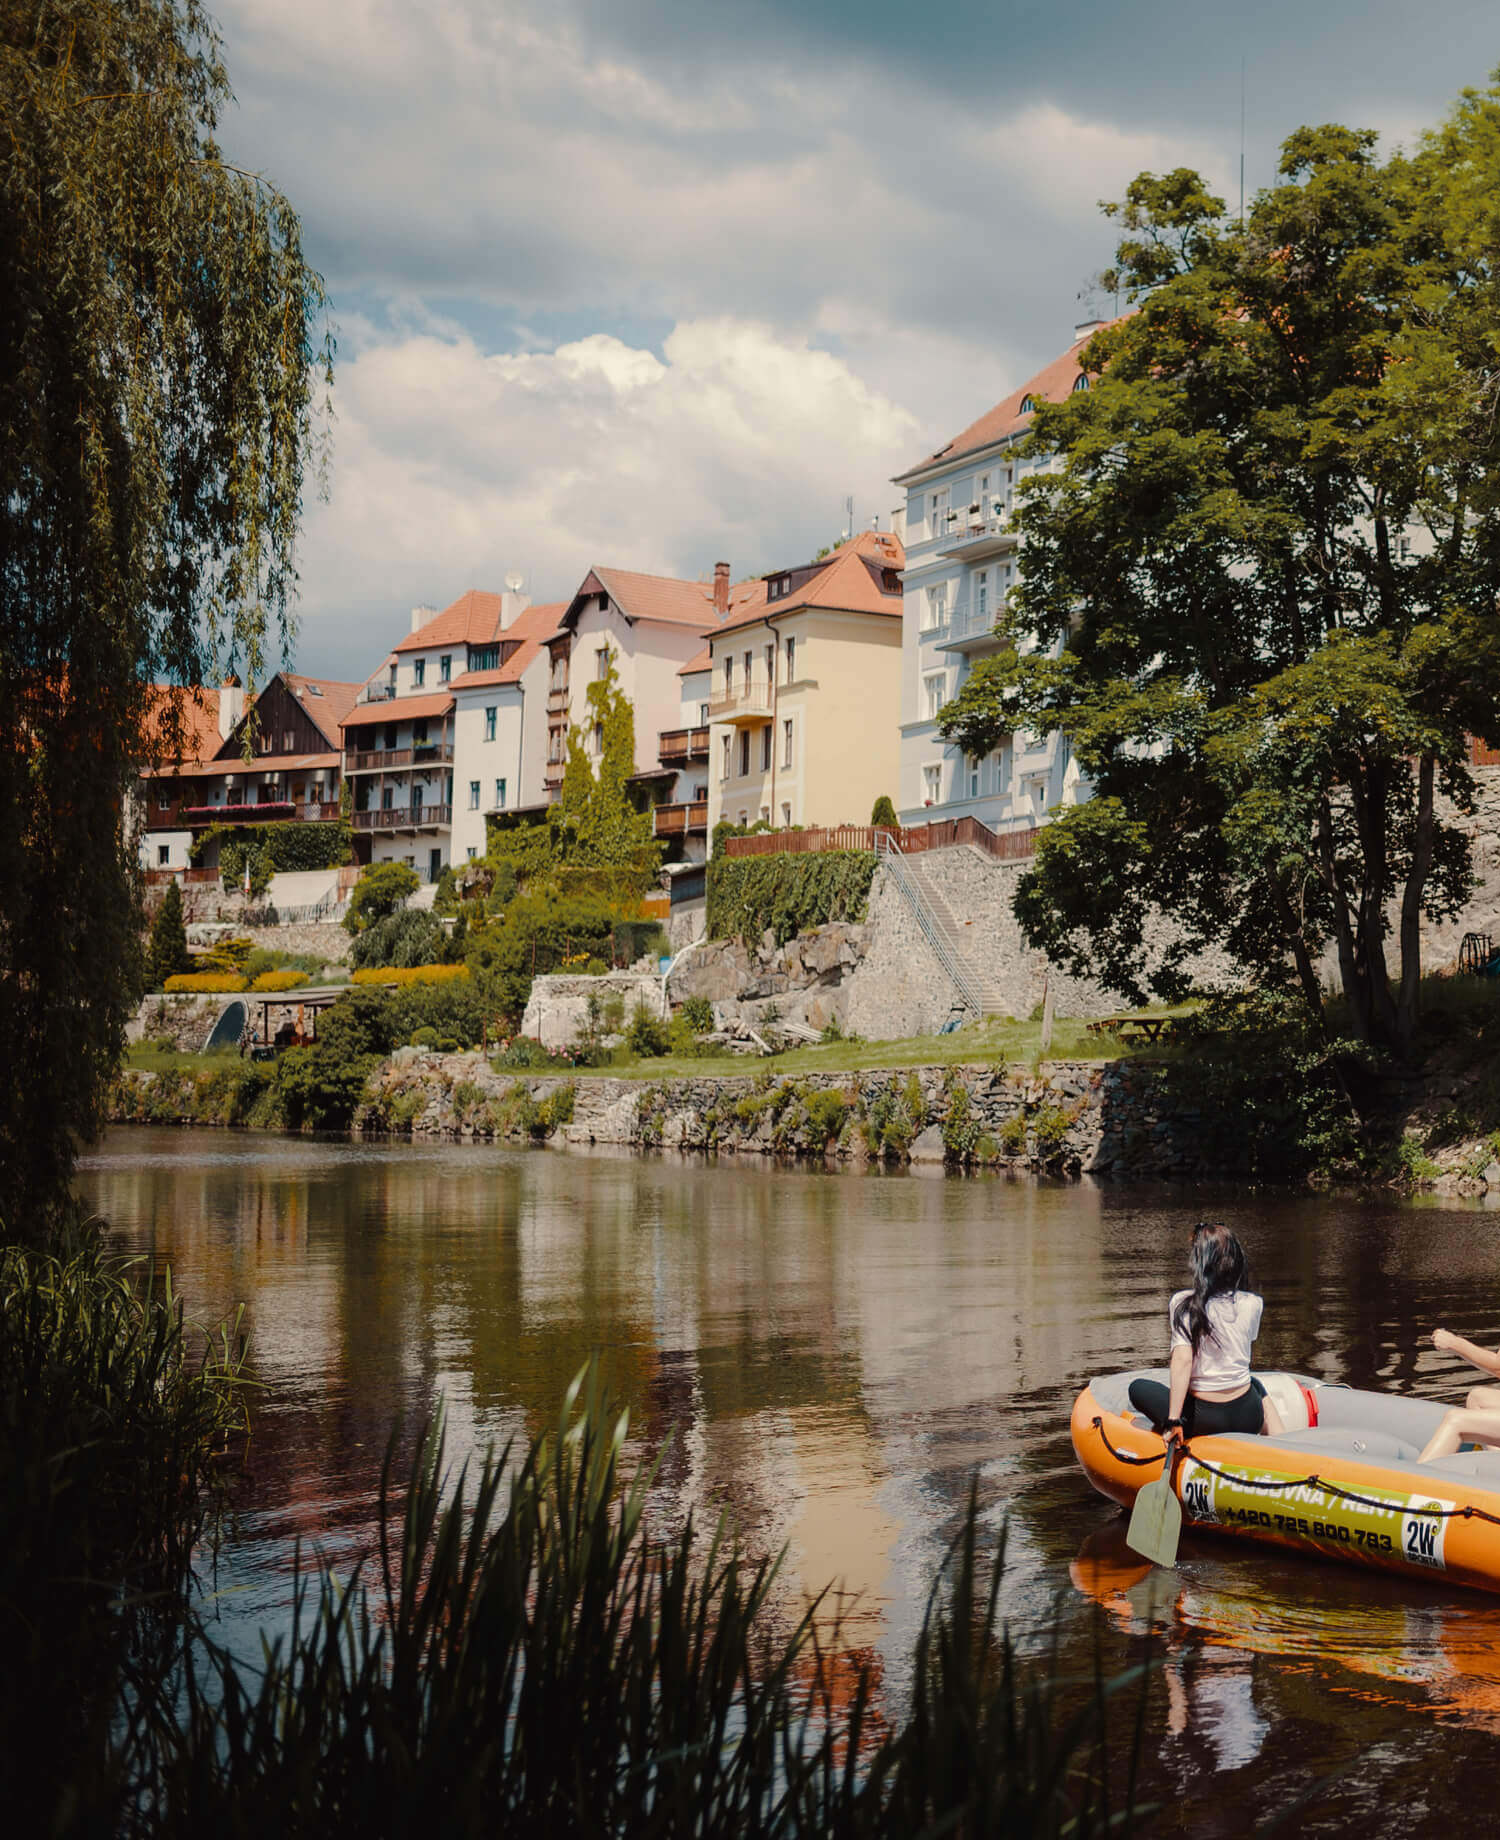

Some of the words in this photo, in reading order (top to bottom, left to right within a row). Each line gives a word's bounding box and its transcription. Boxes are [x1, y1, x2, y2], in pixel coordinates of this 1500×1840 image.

[1186, 1482, 1209, 1513] 2W
[1225, 1507, 1272, 1528] +420
[1274, 1514, 1310, 1534] 725
[1314, 1522, 1351, 1543] 800
[1354, 1529, 1393, 1551] 783
[1407, 1521, 1435, 1556] 2W
